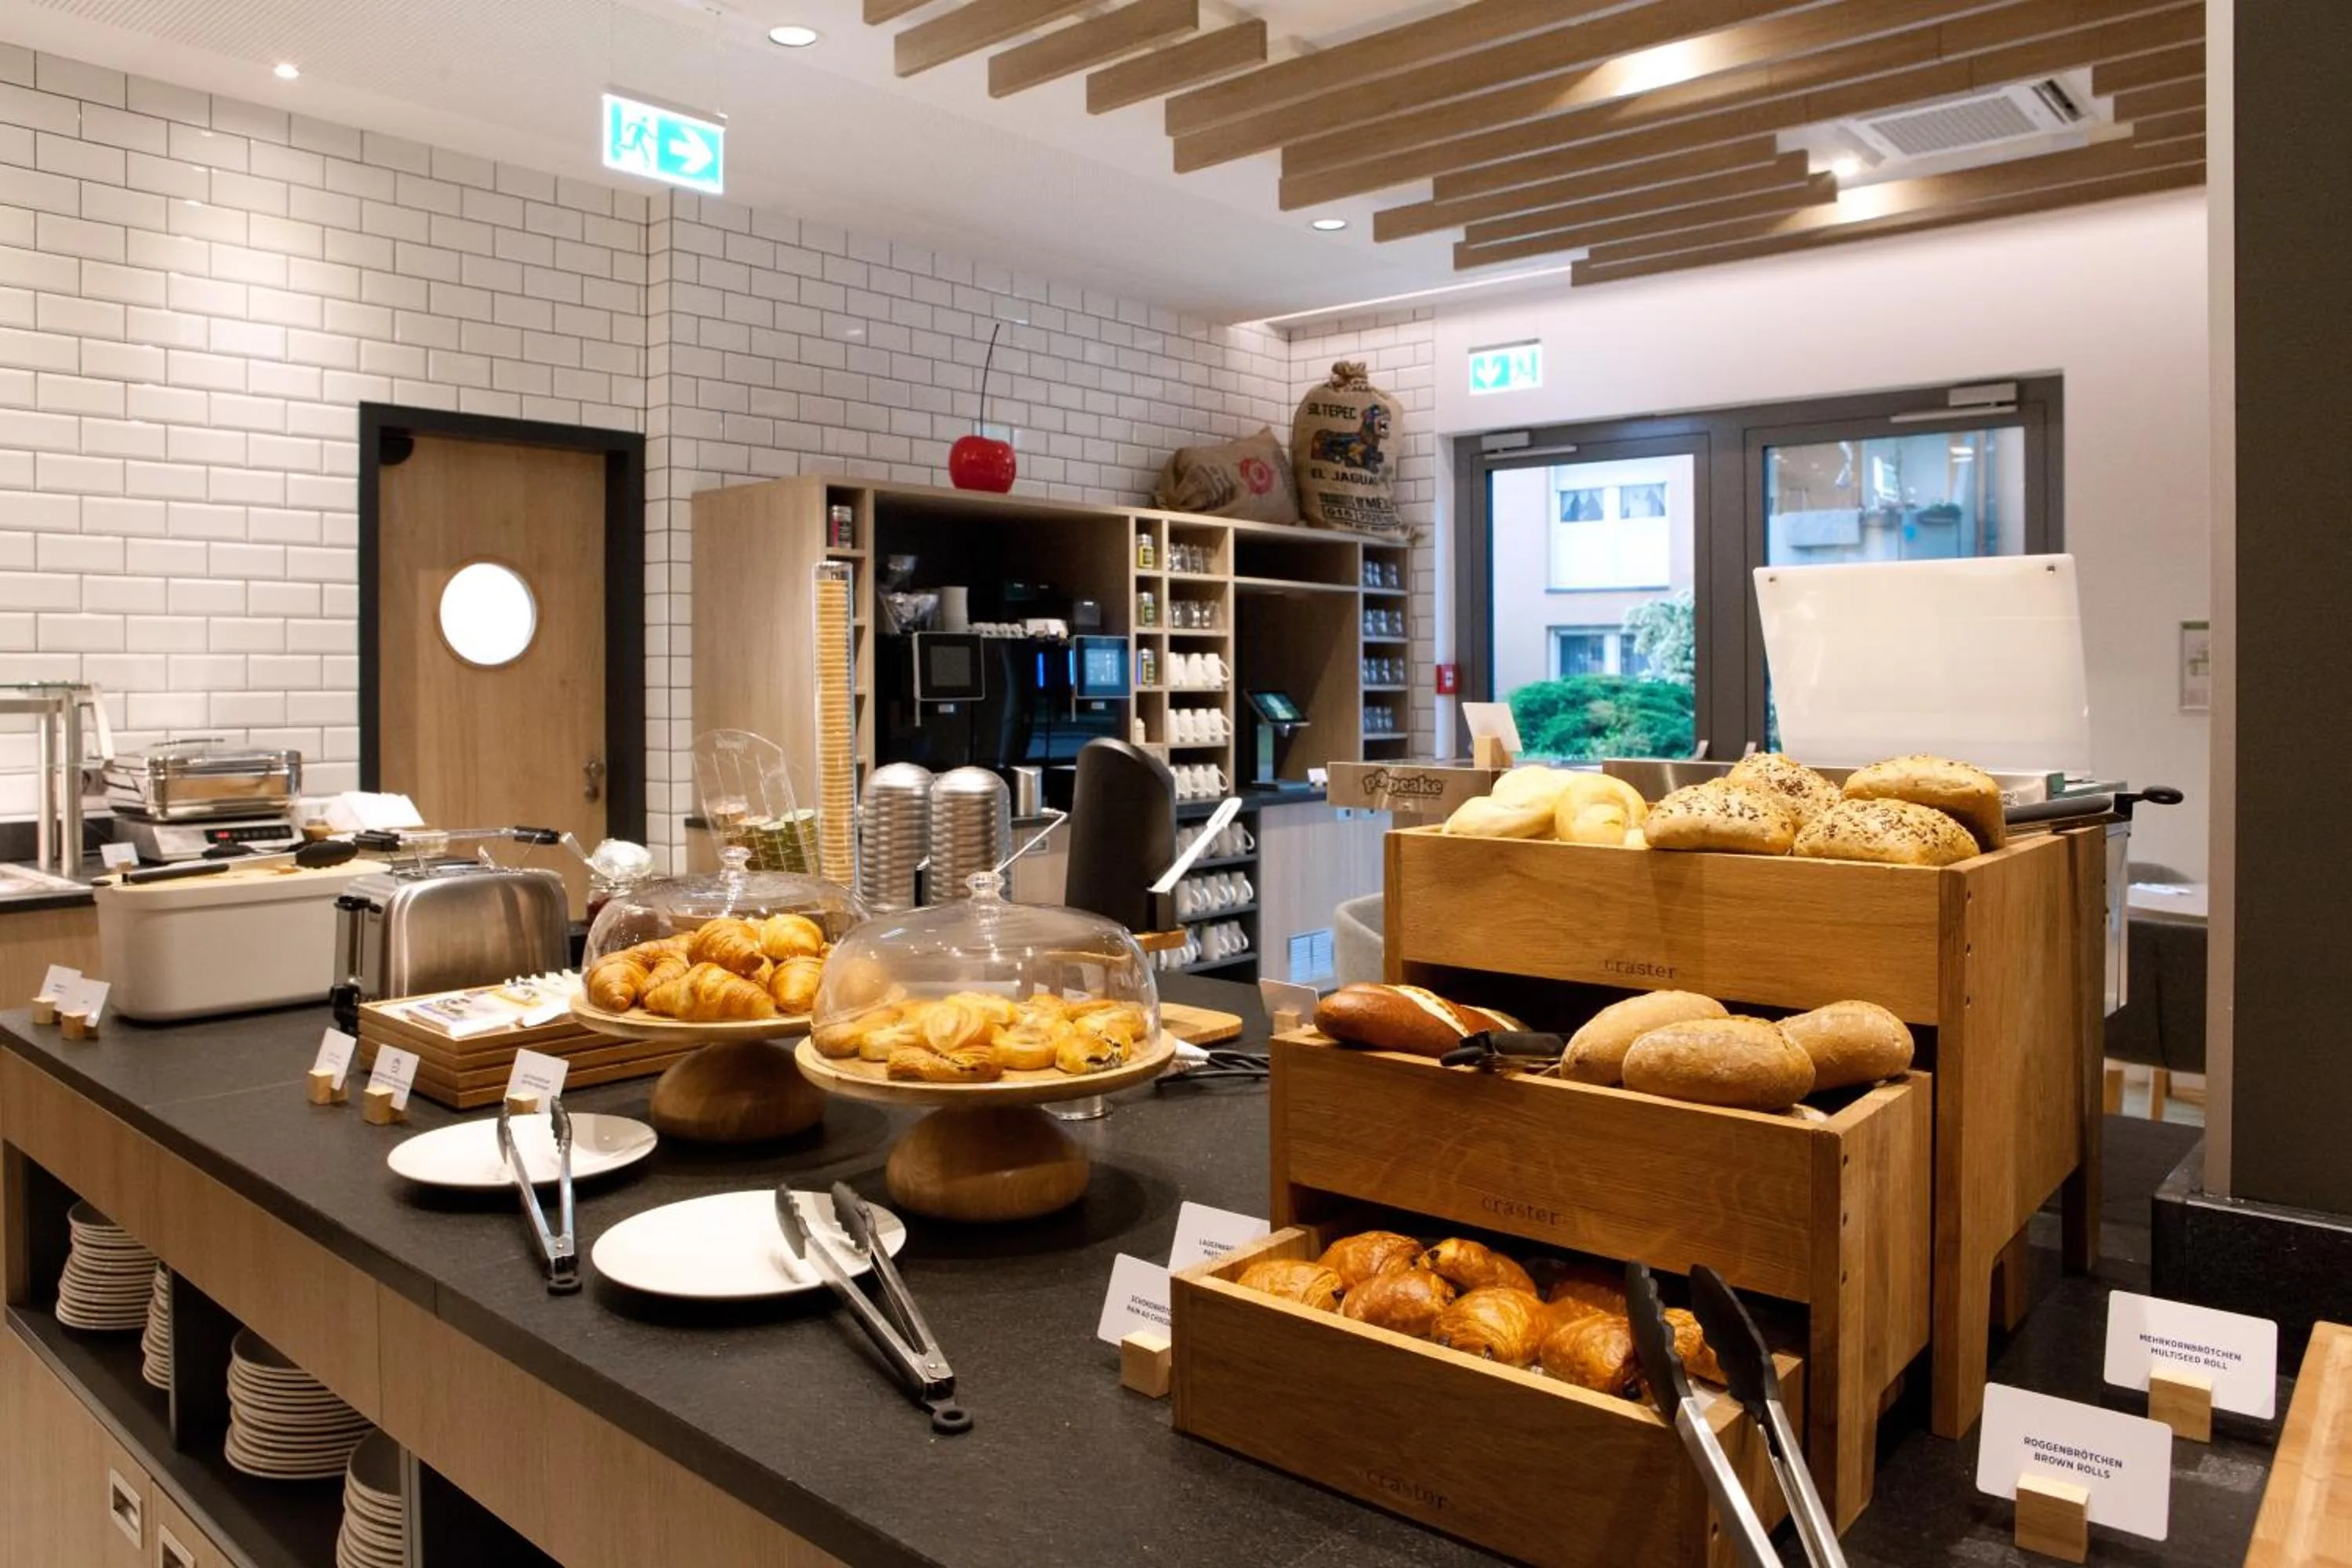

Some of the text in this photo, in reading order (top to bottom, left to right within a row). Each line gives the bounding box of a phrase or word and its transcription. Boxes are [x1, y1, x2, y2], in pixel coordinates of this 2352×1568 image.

[2139, 1333, 2241, 1362] MEHRKORNBRÖTCHEN
[2151, 1347, 2227, 1370] MULTISEED ROLL
[2023, 1436, 2123, 1468] ROGGENBRÖTCHEN
[2034, 1452, 2111, 1479] BROWN ROLLS
